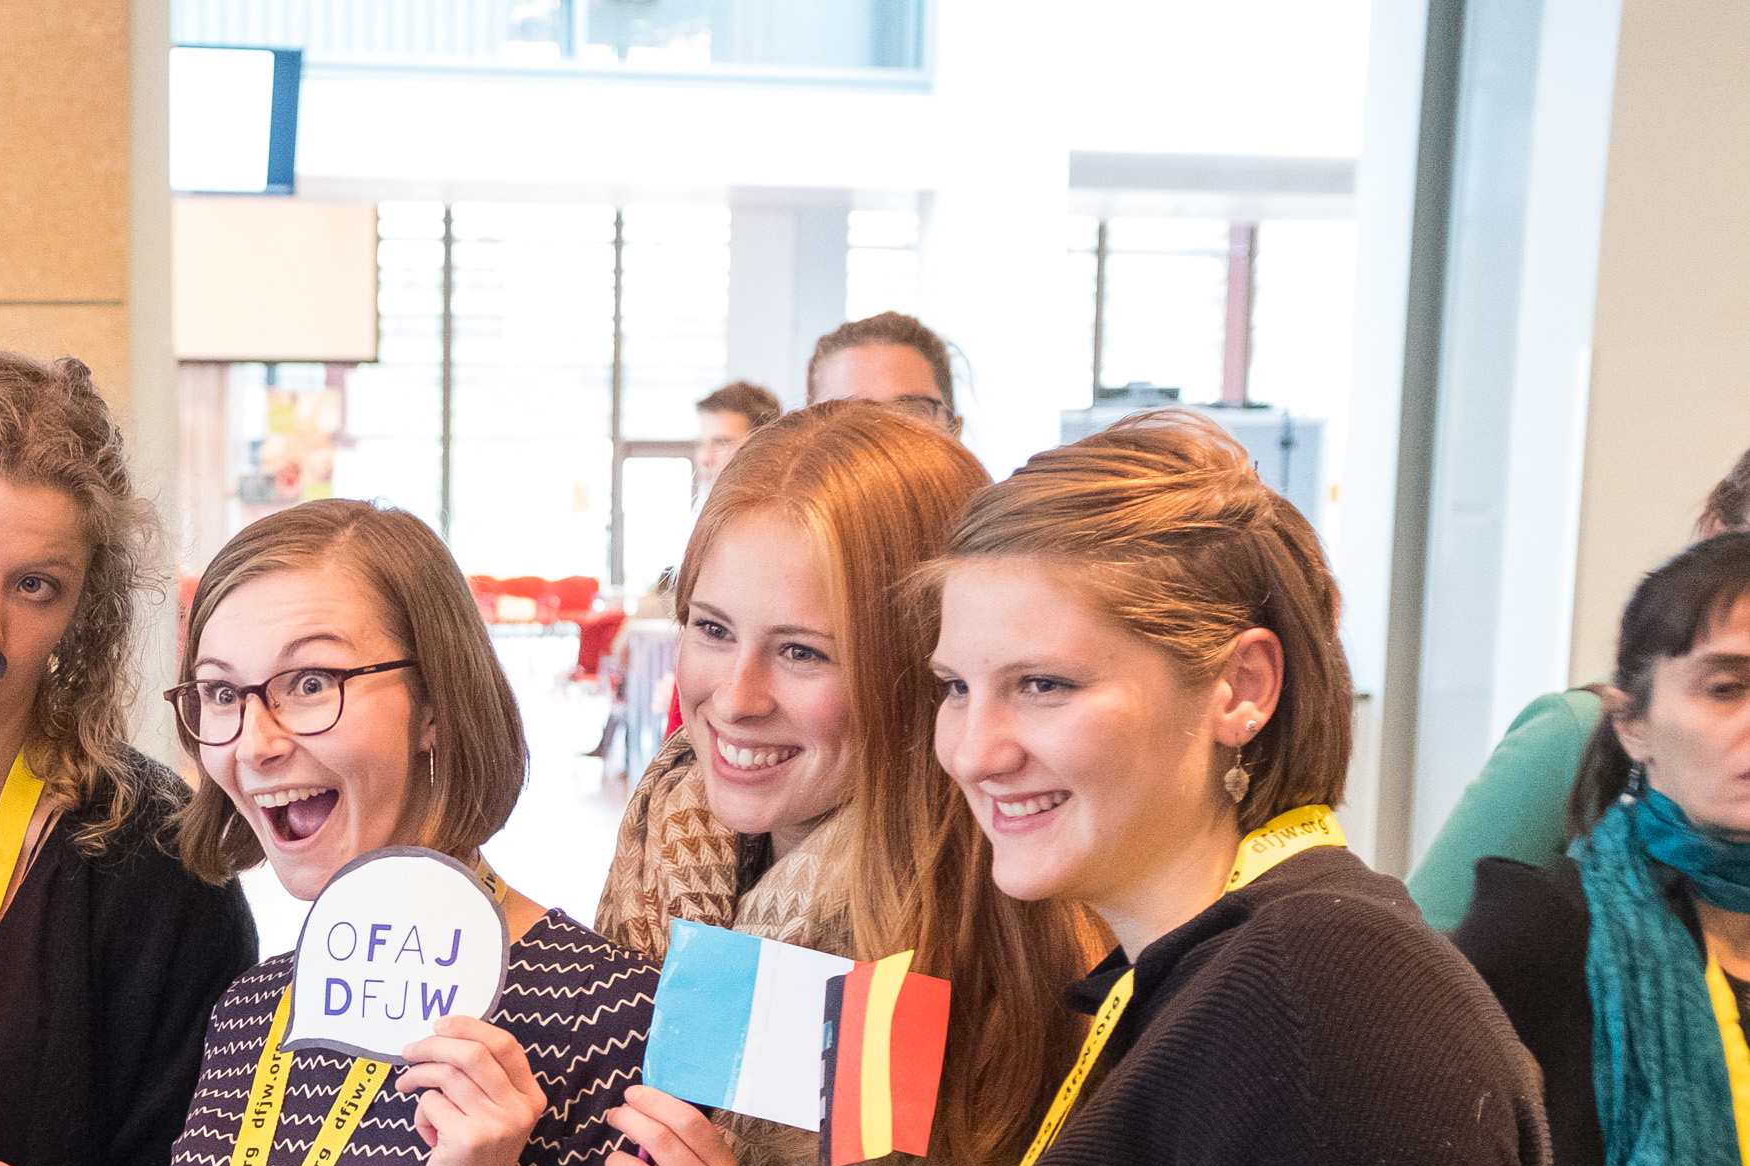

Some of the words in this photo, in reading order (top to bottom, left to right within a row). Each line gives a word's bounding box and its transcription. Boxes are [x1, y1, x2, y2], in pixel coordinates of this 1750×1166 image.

[1251, 818, 1330, 854] dfjw.org
[327, 921, 462, 967] OFAJ
[324, 977, 459, 1021] DFJW
[252, 1043, 282, 1130] dfjw.or
[334, 1062, 378, 1131] dfjw.o
